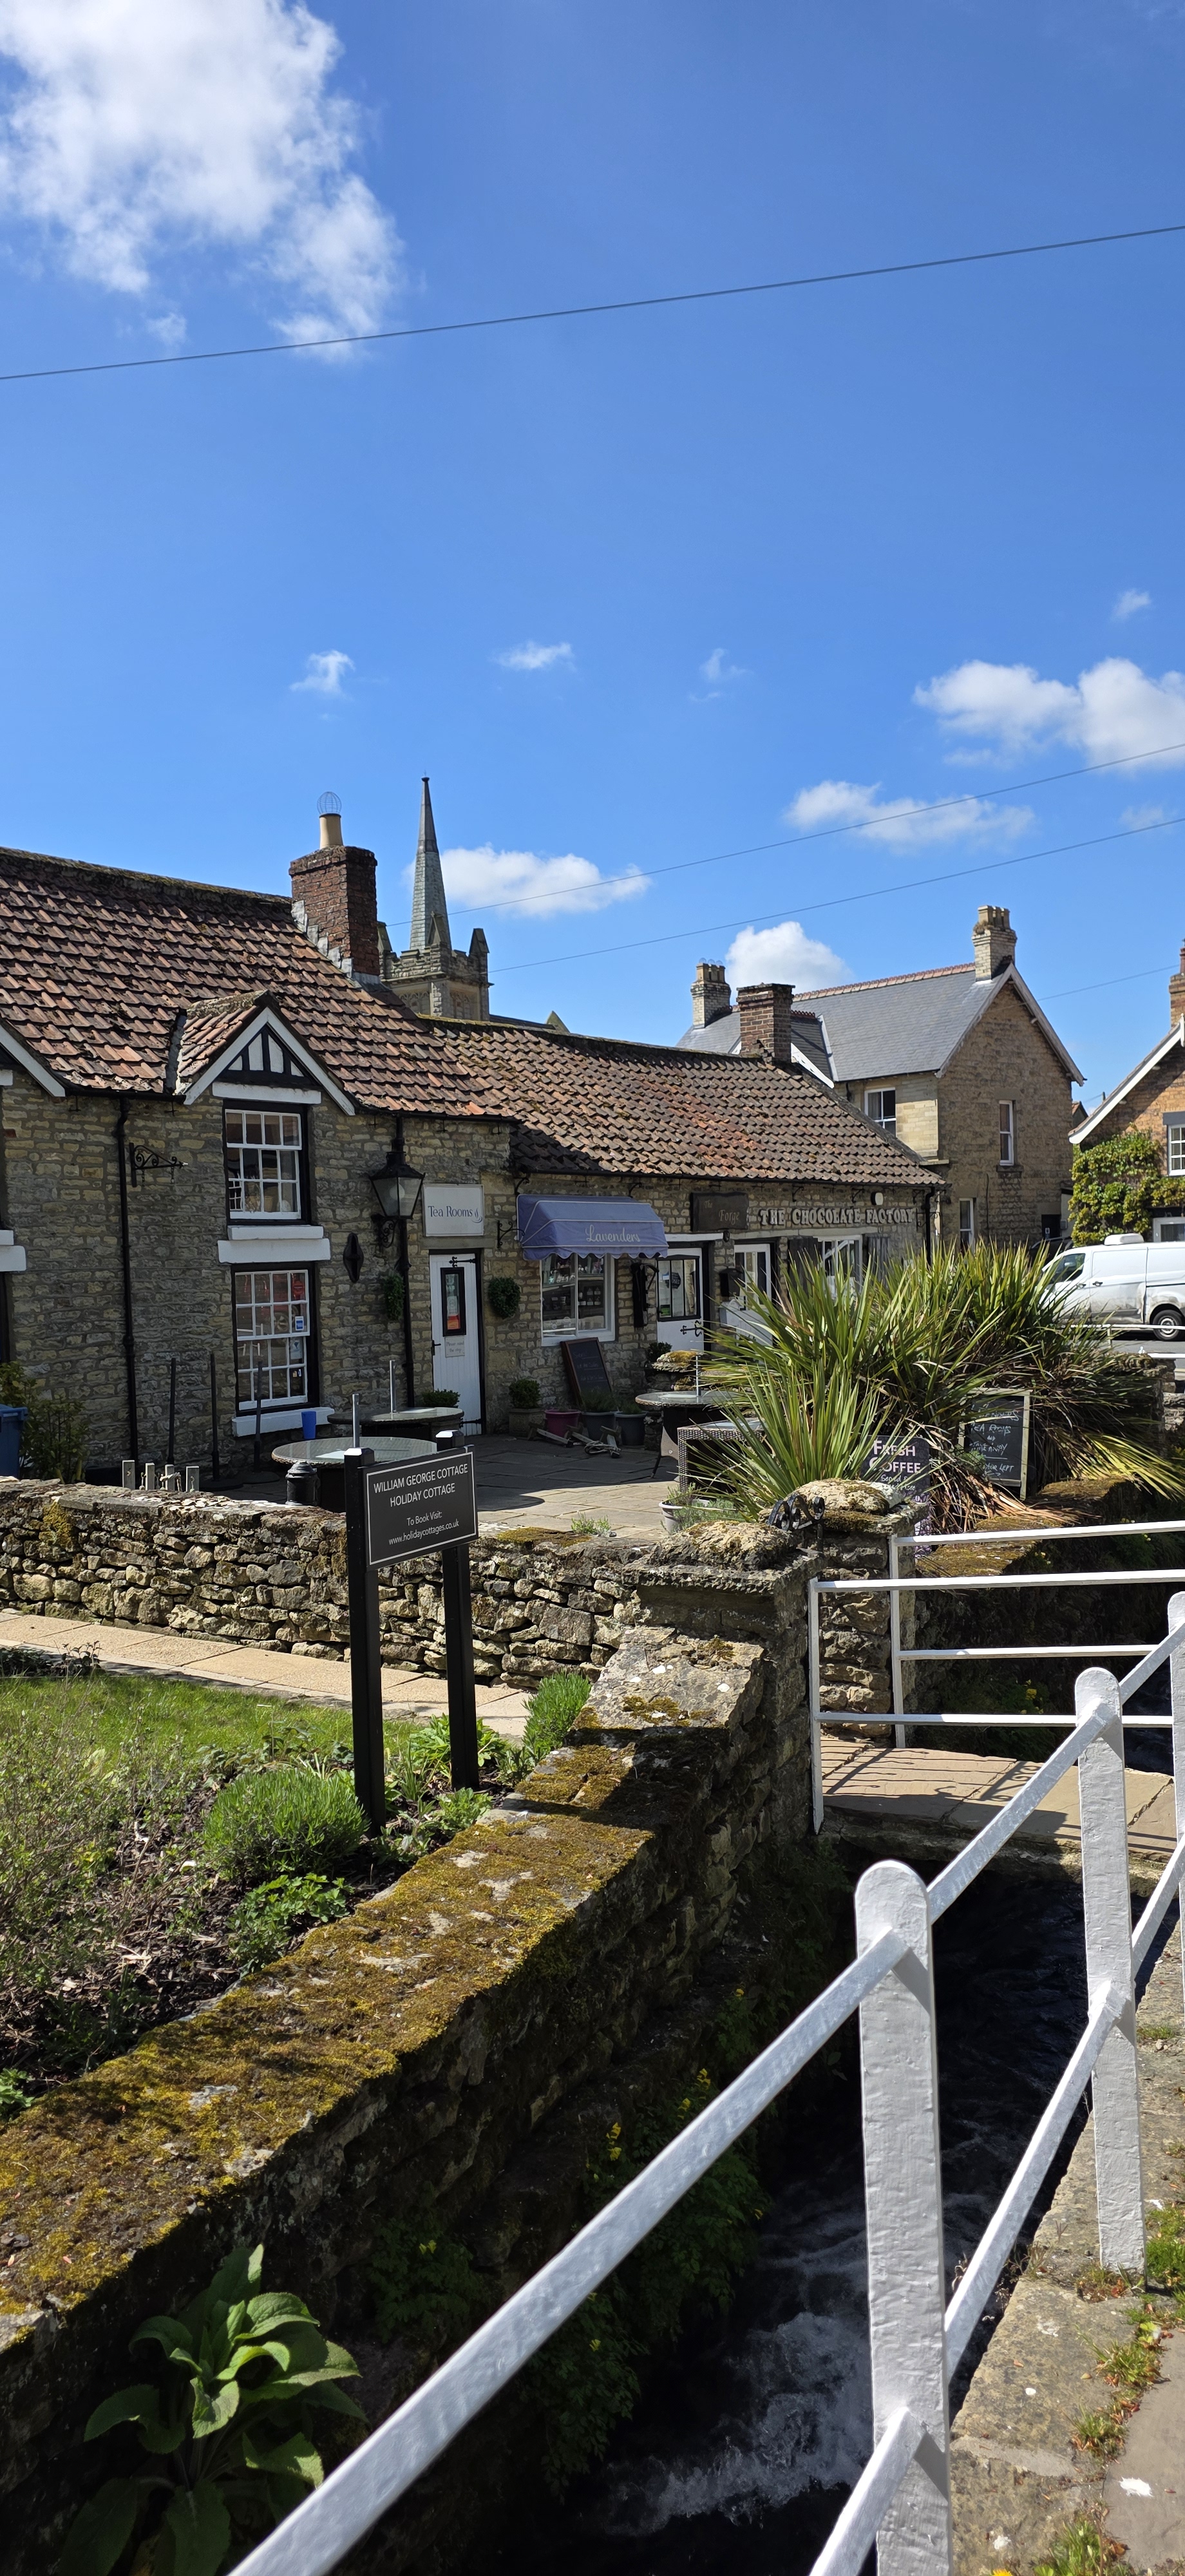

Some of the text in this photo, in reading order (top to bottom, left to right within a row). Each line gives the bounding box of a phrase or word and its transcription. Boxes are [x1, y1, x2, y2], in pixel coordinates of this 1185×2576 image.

[428, 1206, 473, 1217] Tea Rooms
[704, 1200, 713, 1208] The
[719, 1209, 740, 1226] Forge
[760, 1208, 915, 1225] THE CHOCOLATE FACTORY
[585, 1224, 641, 1242] Lavenders
[374, 1463, 468, 1493] WILLIAM GEORGE COTTAGE
[390, 1482, 455, 1507] HOLIDAY COTTAGE
[406, 1517, 414, 1526] To
[415, 1513, 430, 1524] Book
[388, 1519, 459, 1545] www.holidaycottages.co.uk
